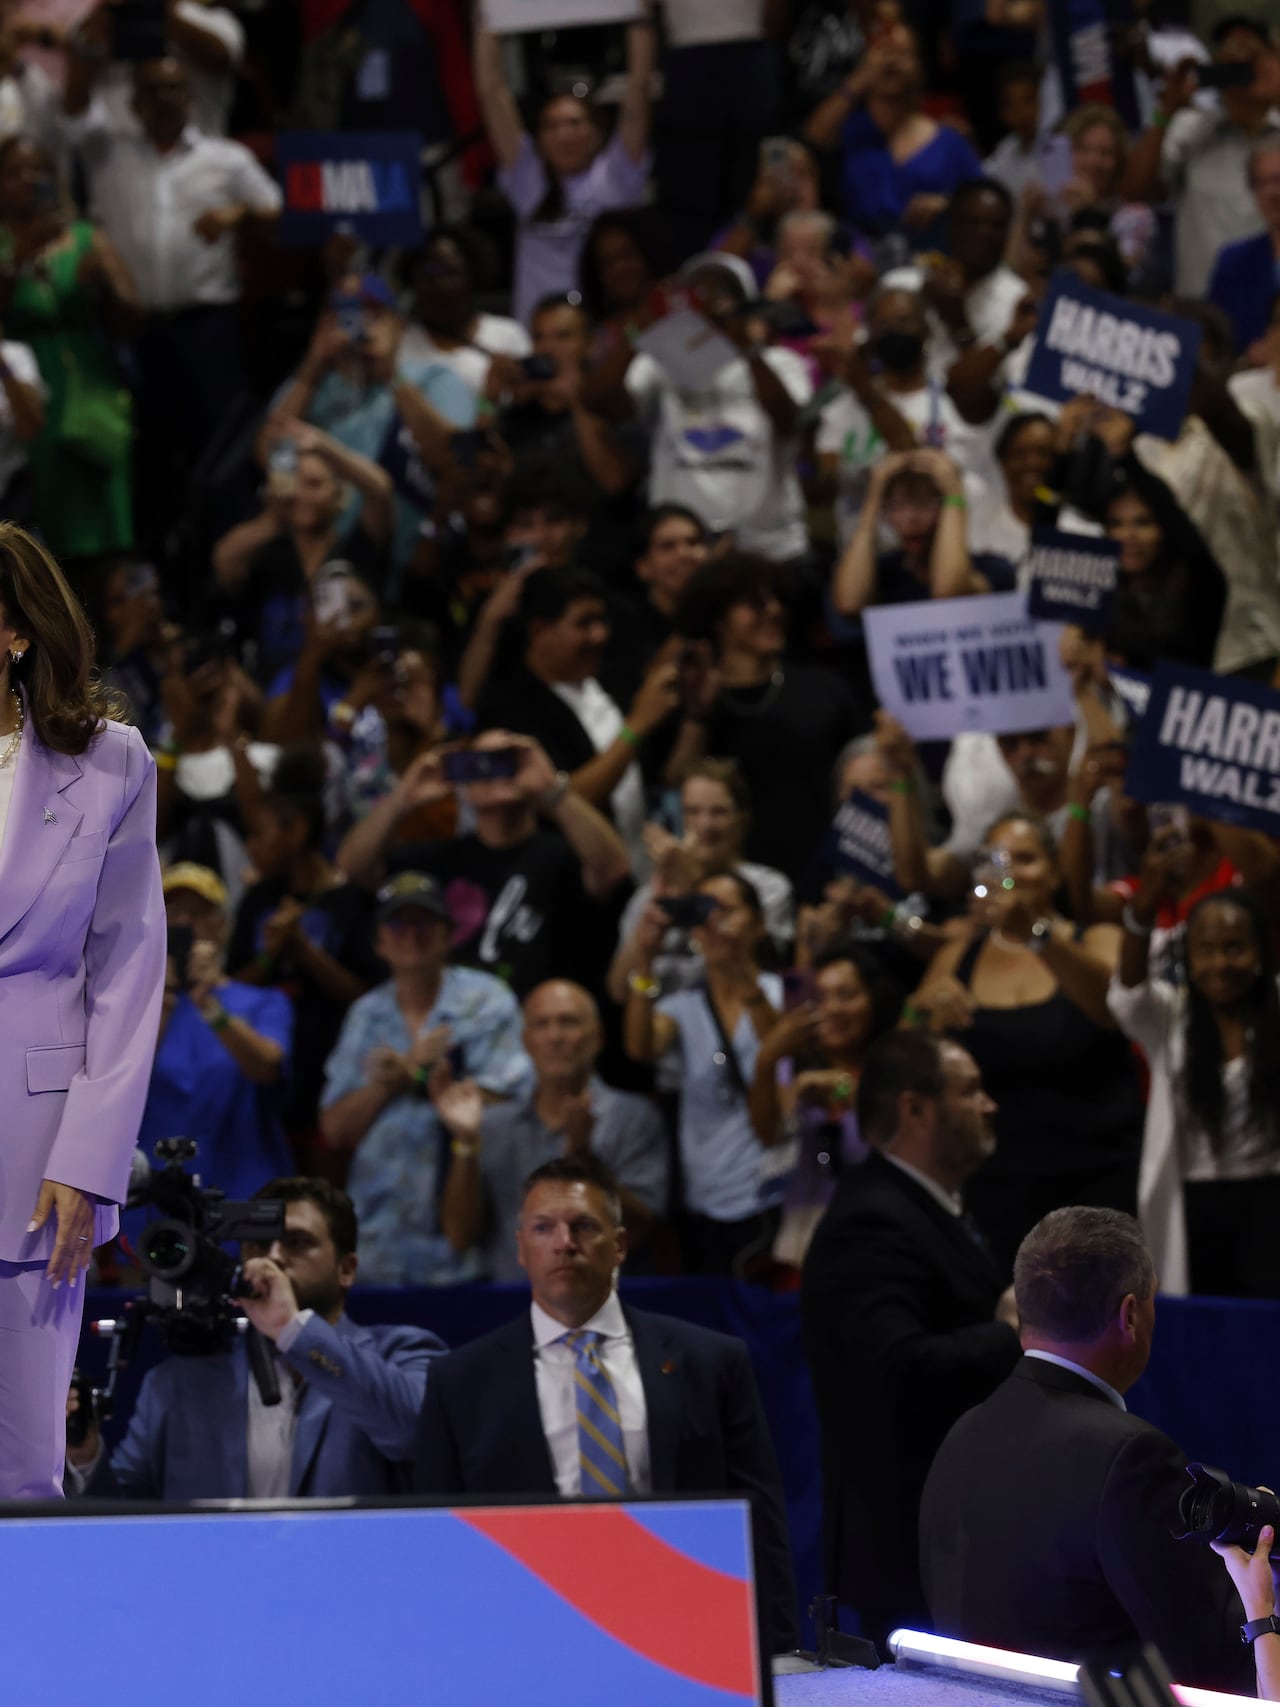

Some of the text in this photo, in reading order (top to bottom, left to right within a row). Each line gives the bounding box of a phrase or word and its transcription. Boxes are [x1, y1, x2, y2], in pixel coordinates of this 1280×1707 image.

[1045, 294, 1182, 390] HARRIS
[1060, 354, 1149, 416] WALZ
[1031, 546, 1118, 592] HARRIS
[893, 652, 954, 705] WE
[960, 640, 1049, 696] WIN
